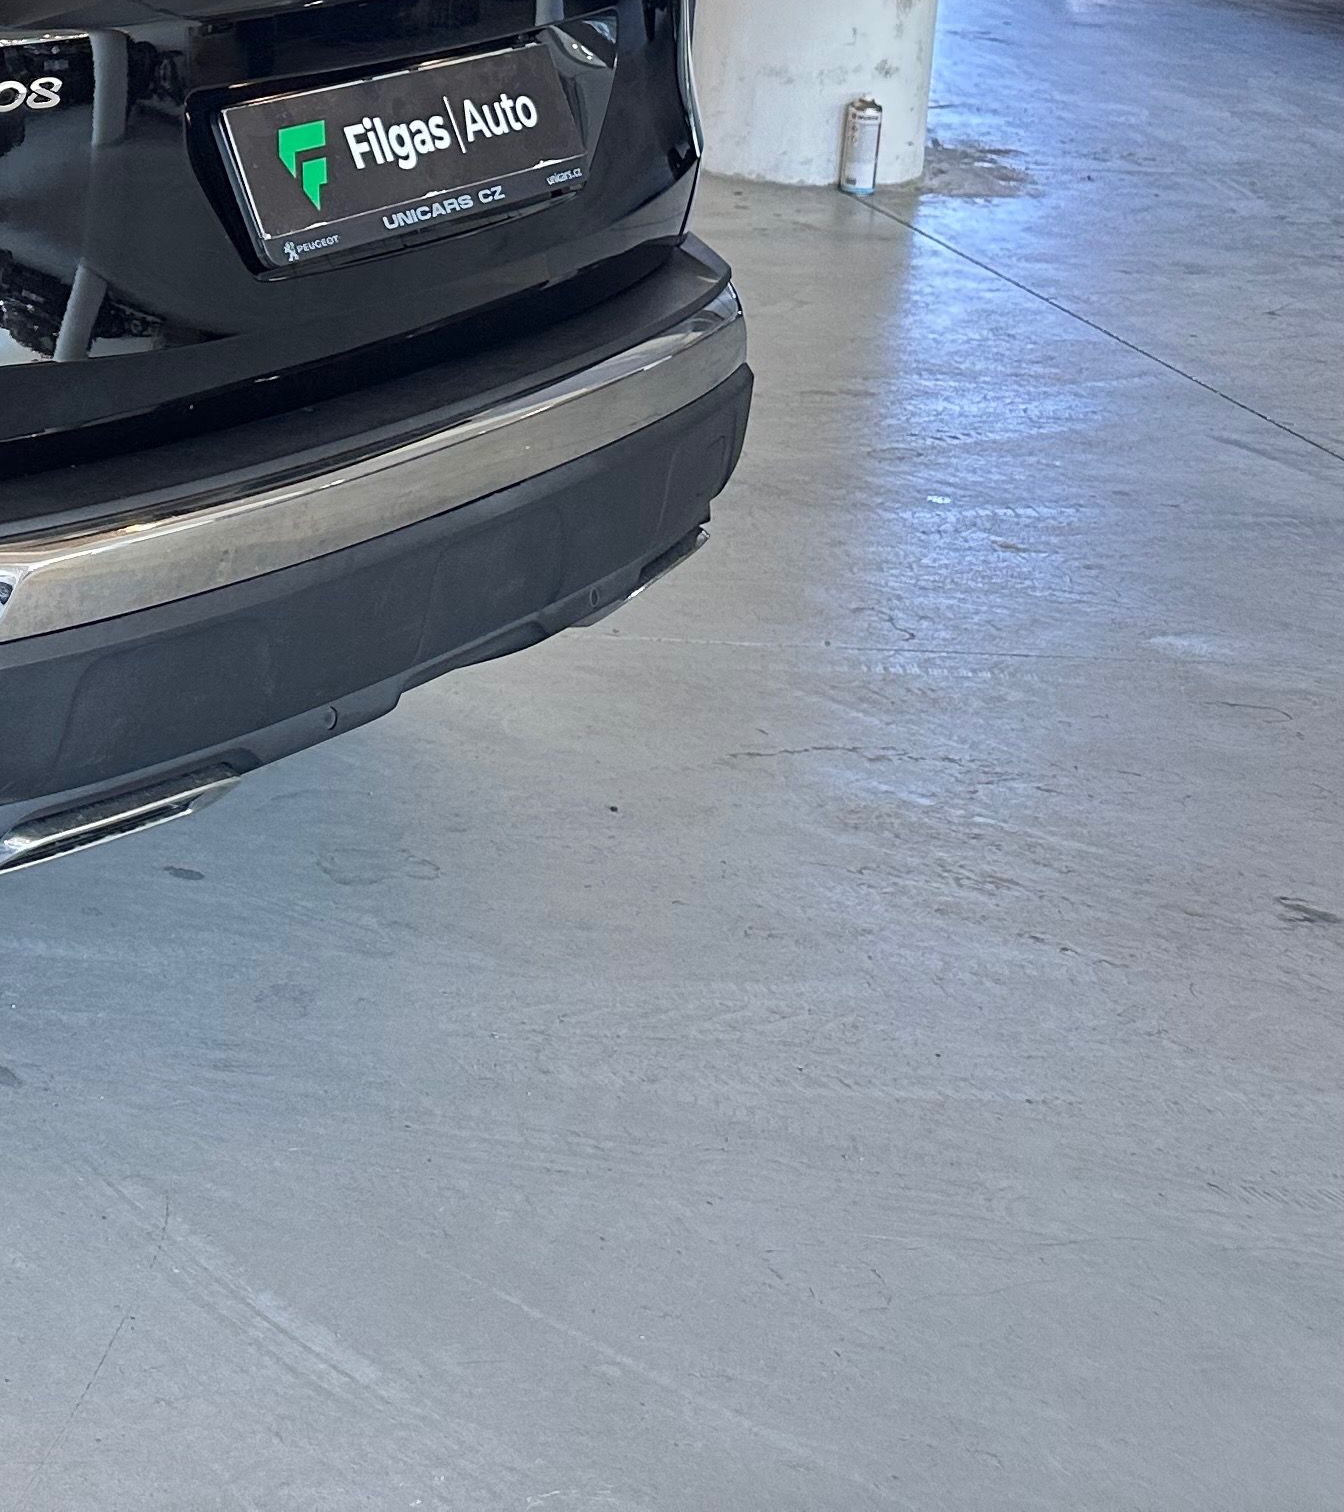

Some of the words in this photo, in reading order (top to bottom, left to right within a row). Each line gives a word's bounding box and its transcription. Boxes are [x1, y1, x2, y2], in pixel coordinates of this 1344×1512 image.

[343, 115, 452, 170] Filgas
[462, 93, 538, 143] Auto
[382, 194, 474, 230] UNICARS
[477, 185, 506, 204] CZ
[296, 234, 339, 254] PEUGEOT
